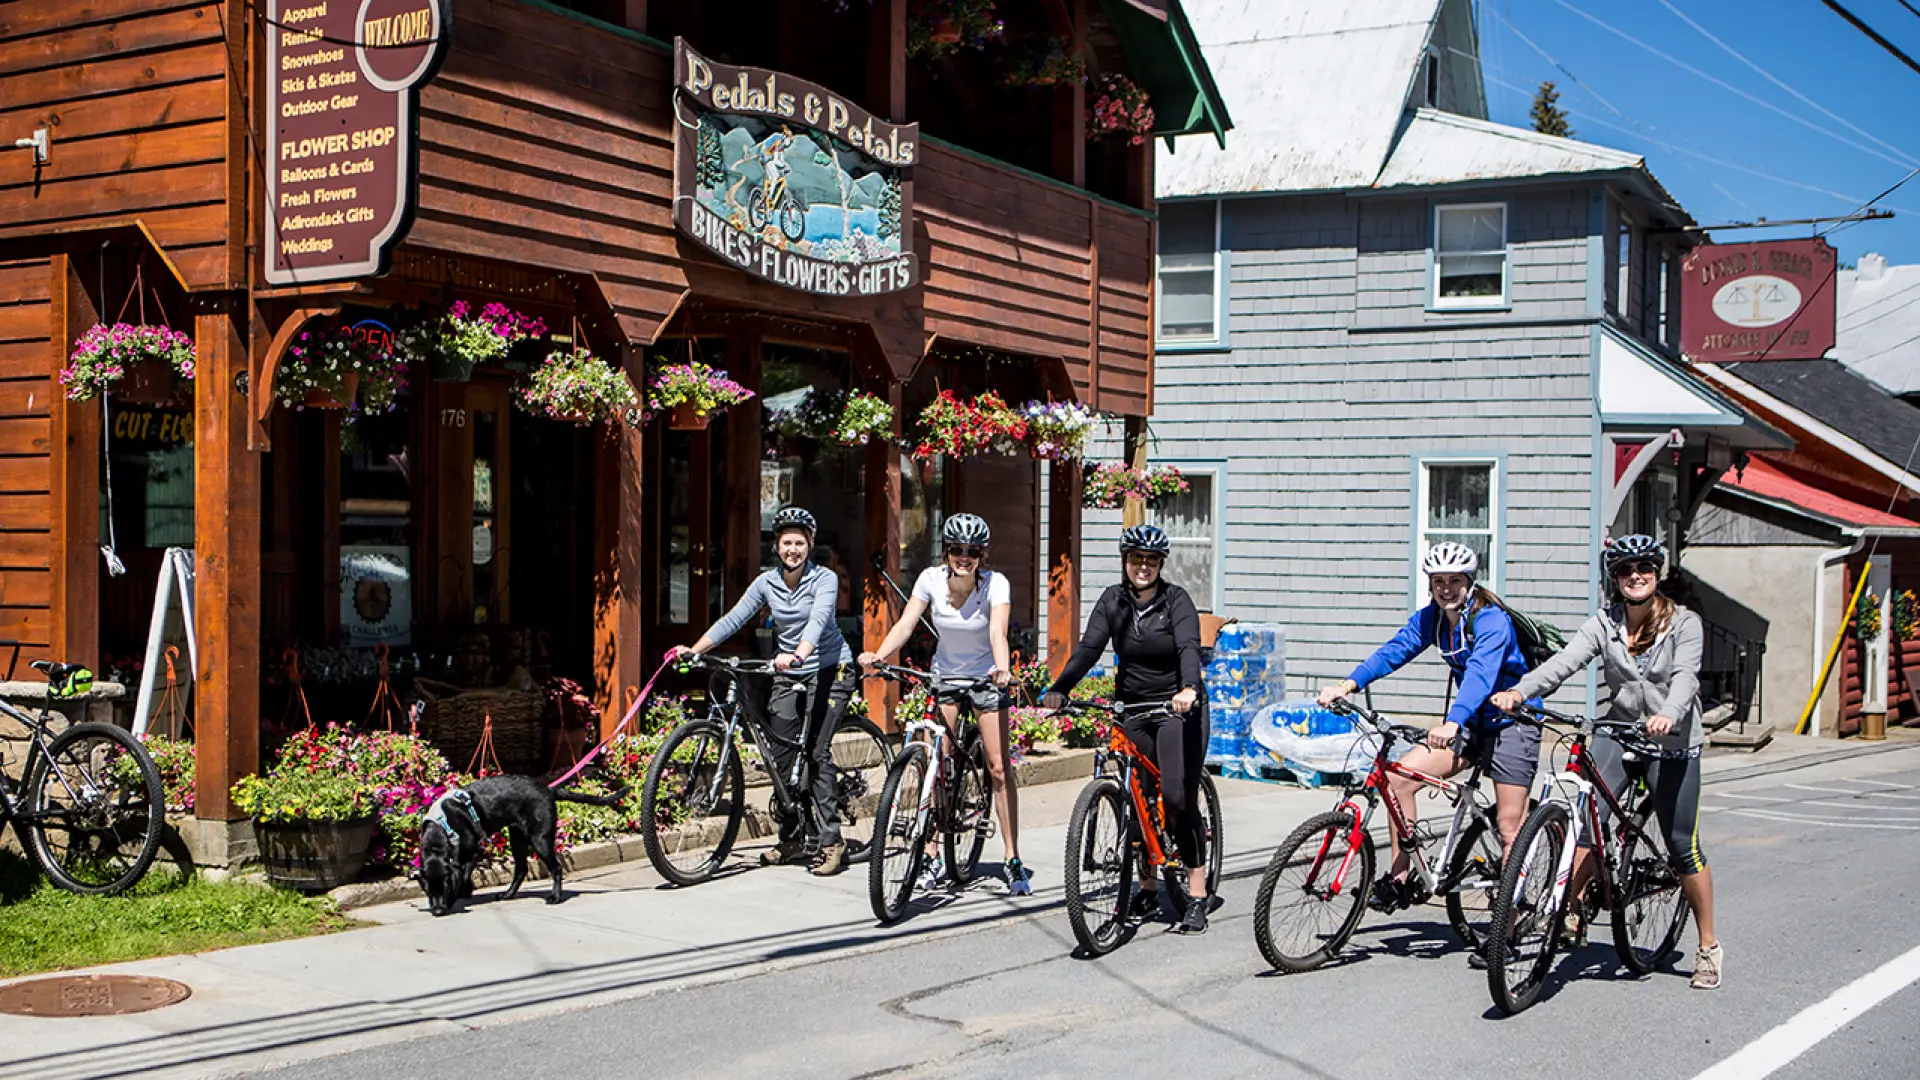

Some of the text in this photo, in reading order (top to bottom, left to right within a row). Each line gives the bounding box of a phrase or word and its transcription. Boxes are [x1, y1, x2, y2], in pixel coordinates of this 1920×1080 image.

[283, 2, 327, 24] Apparel
[282, 27, 324, 47] Rentals
[364, 8, 430, 49] WELCOME
[282, 48, 344, 71] Snowshoes
[281, 70, 357, 94] Skis & Skates
[282, 94, 359, 118] Outdoor Gear
[685, 51, 914, 165] Pedals & Petals
[281, 126, 396, 160] FLOWER SHOP
[281, 158, 374, 184] Balloons & Cards
[281, 185, 357, 208] Fresh Flowers
[281, 207, 374, 231] Adirondack Gifts
[281, 236, 334, 255] Weddings
[691, 202, 910, 294] BIKES FLOWERS GIFTS
[114, 411, 152, 440] CUT
[440, 409, 466, 428] 176
